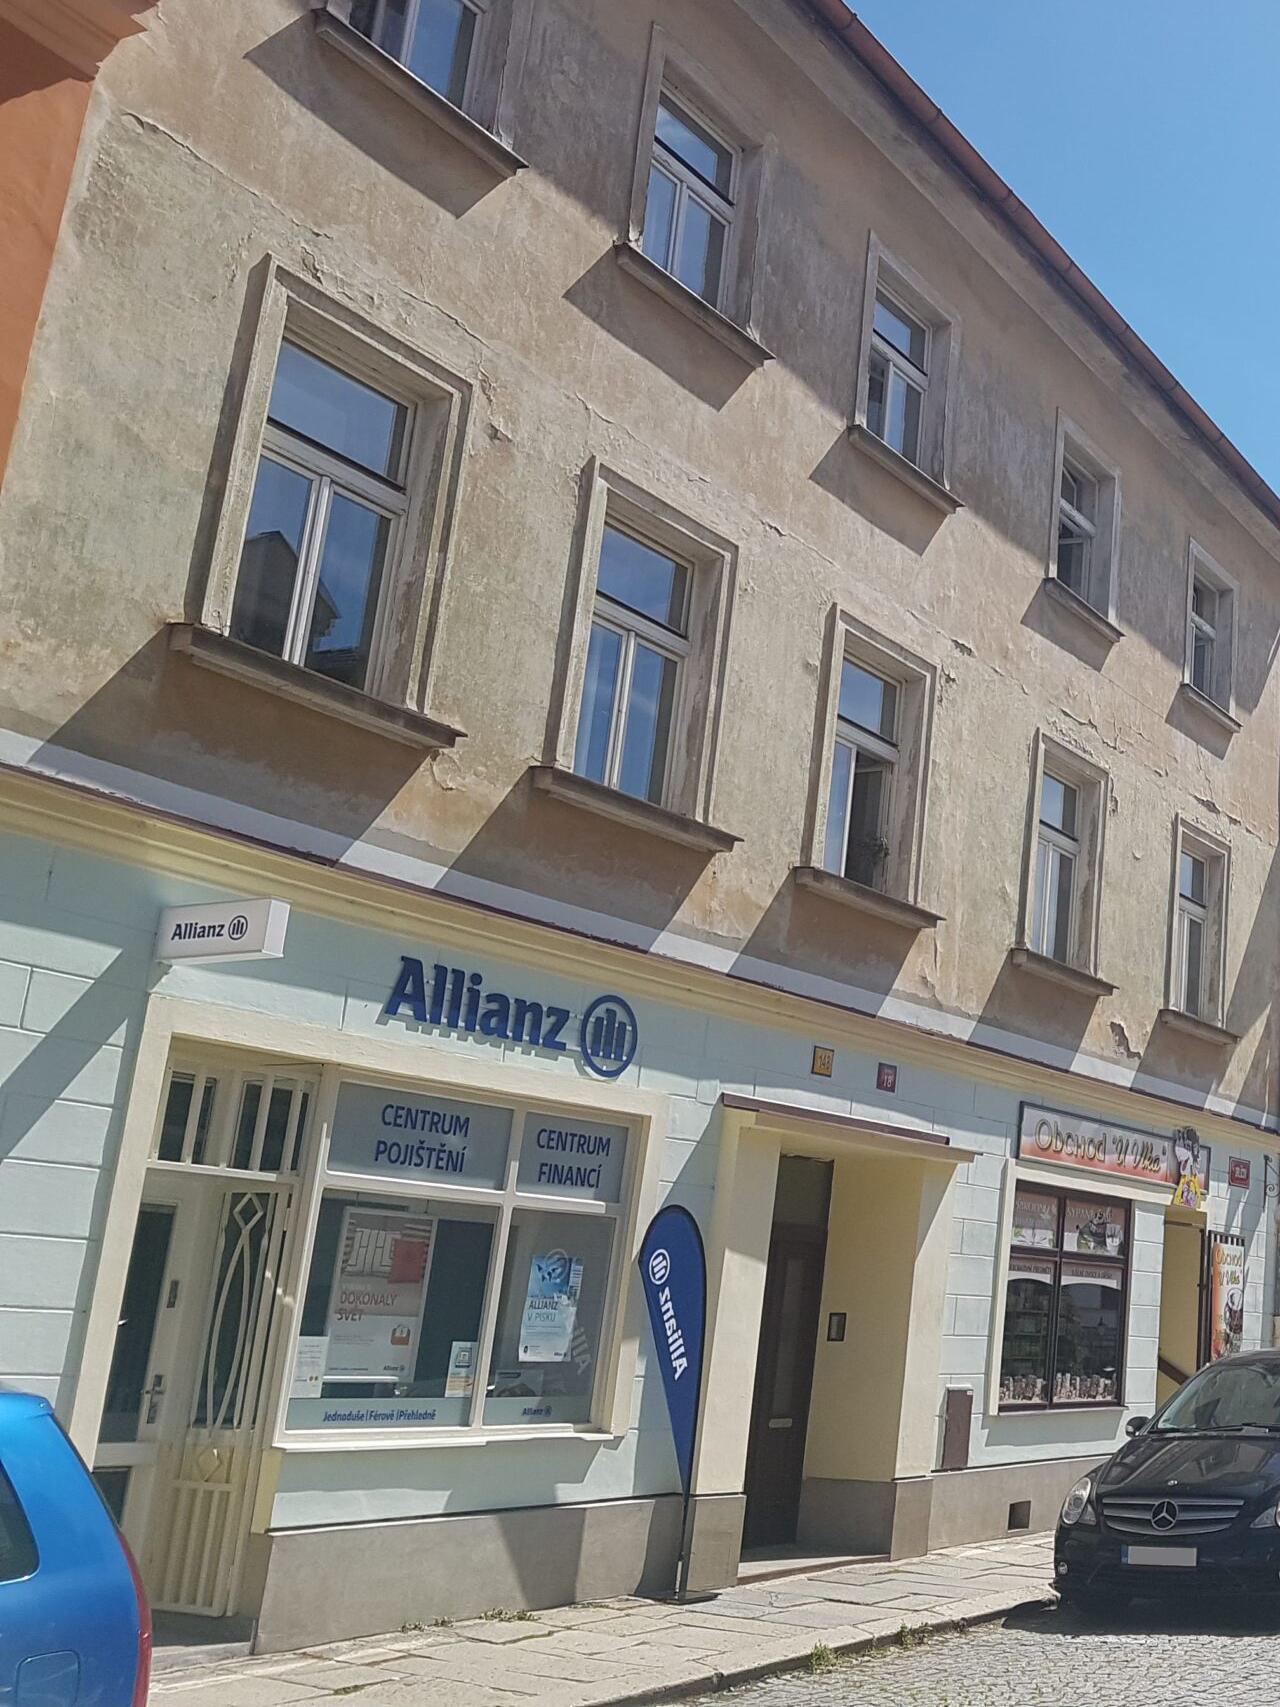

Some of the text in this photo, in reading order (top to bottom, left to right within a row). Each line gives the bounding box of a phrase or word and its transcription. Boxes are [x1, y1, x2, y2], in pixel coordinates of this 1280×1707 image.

[171, 921, 225, 941] Allianz
[385, 956, 570, 1051] Allianz
[381, 1104, 470, 1138] CENTRUM
[374, 1139, 467, 1173] POJIŠTĚNÍ
[537, 1128, 611, 1157] CENTRUM
[538, 1163, 602, 1188] FINANCÍ
[529, 1300, 558, 1310] ALLIANZ
[323, 1409, 365, 1422] Jednoduše
[400, 1408, 436, 1420] Přehledně
